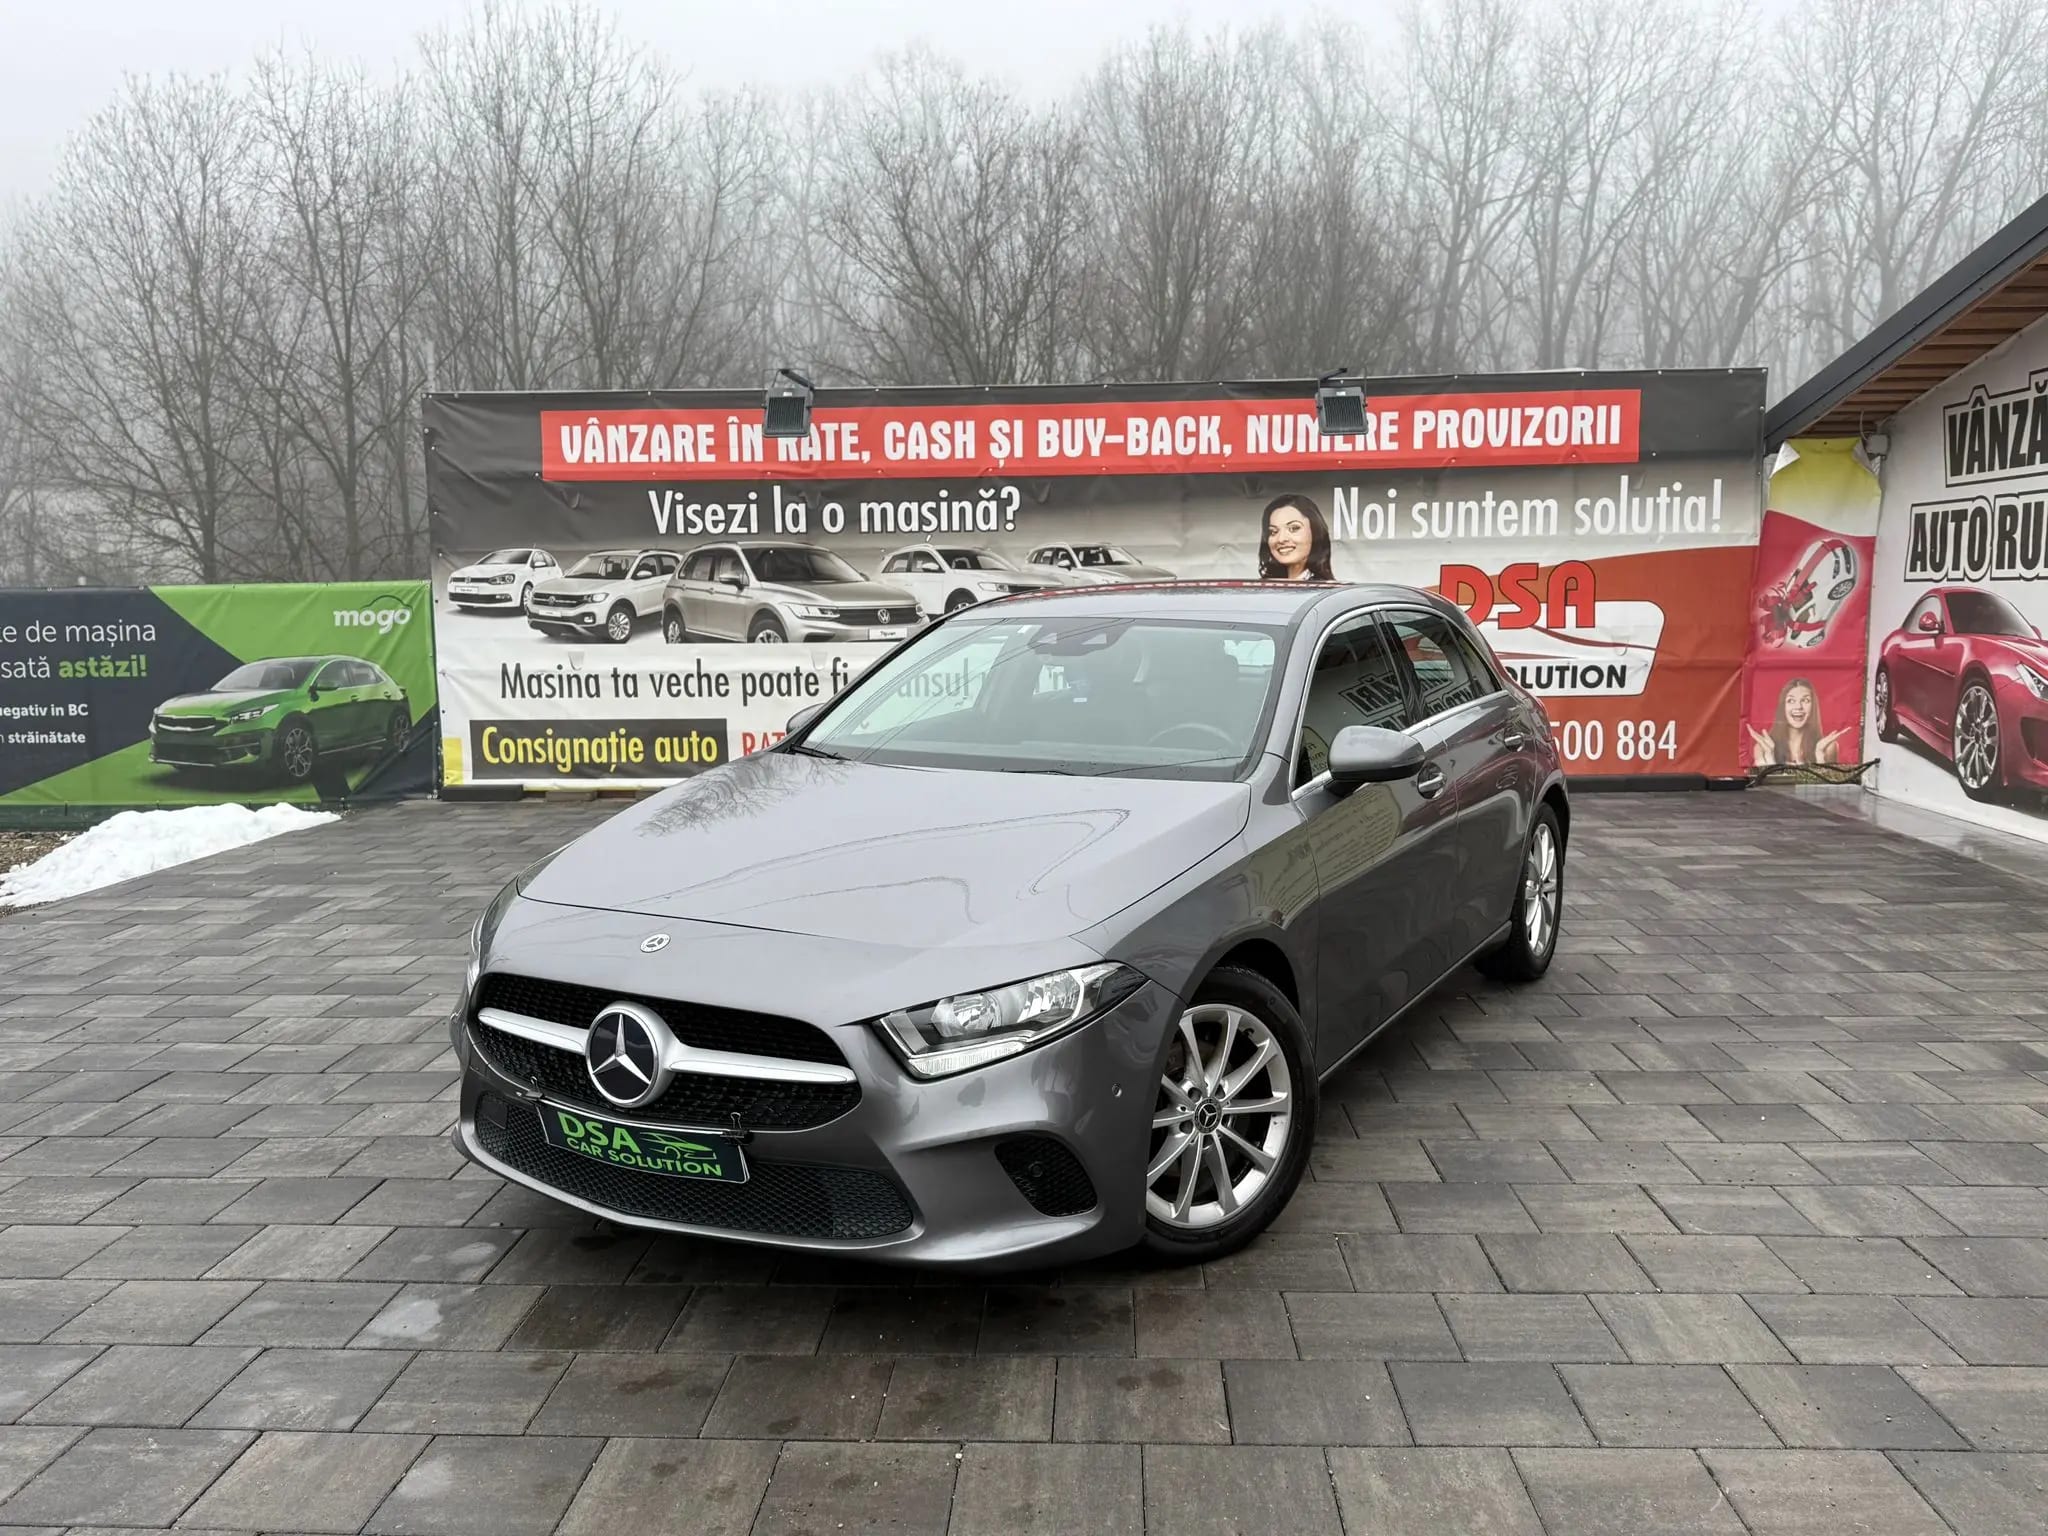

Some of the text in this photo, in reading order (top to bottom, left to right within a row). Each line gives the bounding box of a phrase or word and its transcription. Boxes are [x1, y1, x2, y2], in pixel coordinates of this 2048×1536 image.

[560, 416, 716, 463] VÂNZARE
[727, 415, 764, 463] ÎN
[884, 420, 976, 461] CASH
[989, 418, 1023, 468] ȘI
[1413, 404, 1622, 450] PROVIZORII
[648, 484, 1021, 543] Visezi la o mașină?
[1333, 474, 1722, 545] Noi suntem soluția!
[1909, 500, 2048, 573] AUTO RU
[1439, 560, 1597, 630] DSA
[25, 620, 57, 643] de
[65, 618, 156, 648] mașina
[333, 607, 412, 635] mogo
[58, 654, 148, 678] astăzi!
[500, 662, 600, 699] Masina
[611, 667, 639, 698] ta
[649, 658, 730, 698] veche
[741, 666, 819, 707] poate
[830, 656, 848, 695] fi
[51, 703, 65, 716] in
[68, 703, 89, 716] BC
[8, 731, 86, 744] străinătate
[482, 726, 719, 774] Consignație auto
[1616, 719, 1677, 761] 884
[557, 1111, 642, 1154] DSA
[566, 1137, 723, 1177] CAR SOLUTION
